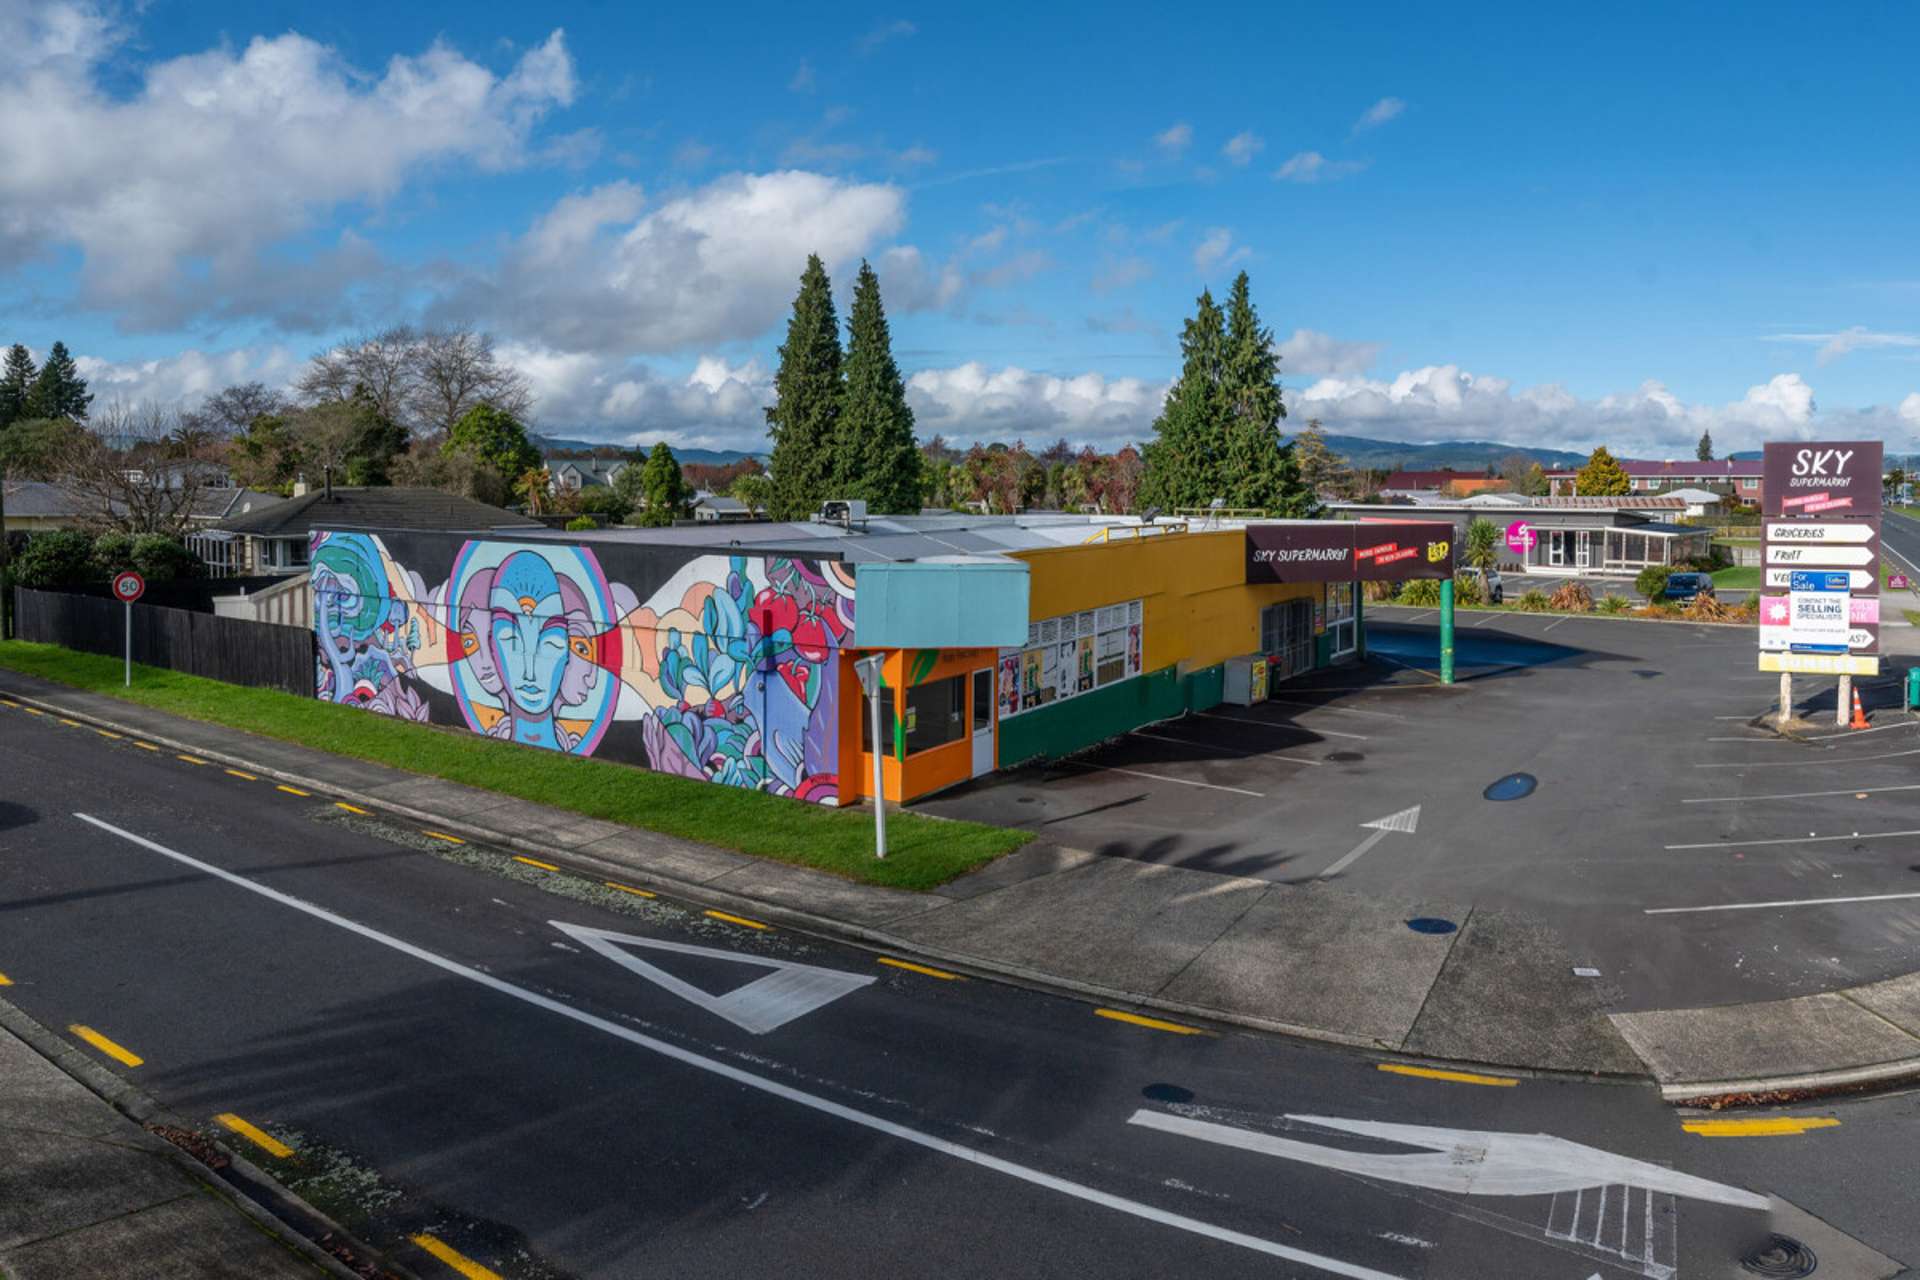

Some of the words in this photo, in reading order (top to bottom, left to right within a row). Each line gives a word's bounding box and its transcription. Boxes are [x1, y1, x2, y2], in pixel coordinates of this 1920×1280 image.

[1791, 449, 1854, 475] SKY
[1773, 528, 1825, 538] GROCERIES
[1253, 550, 1276, 562] SKY
[1277, 548, 1349, 562] SUPERMARKET
[1774, 550, 1802, 560] FRUIT
[1792, 572, 1807, 580] For
[121, 581, 138, 592] 50
[1792, 581, 1815, 591] Sale
[1797, 604, 1842, 613] SELLING
